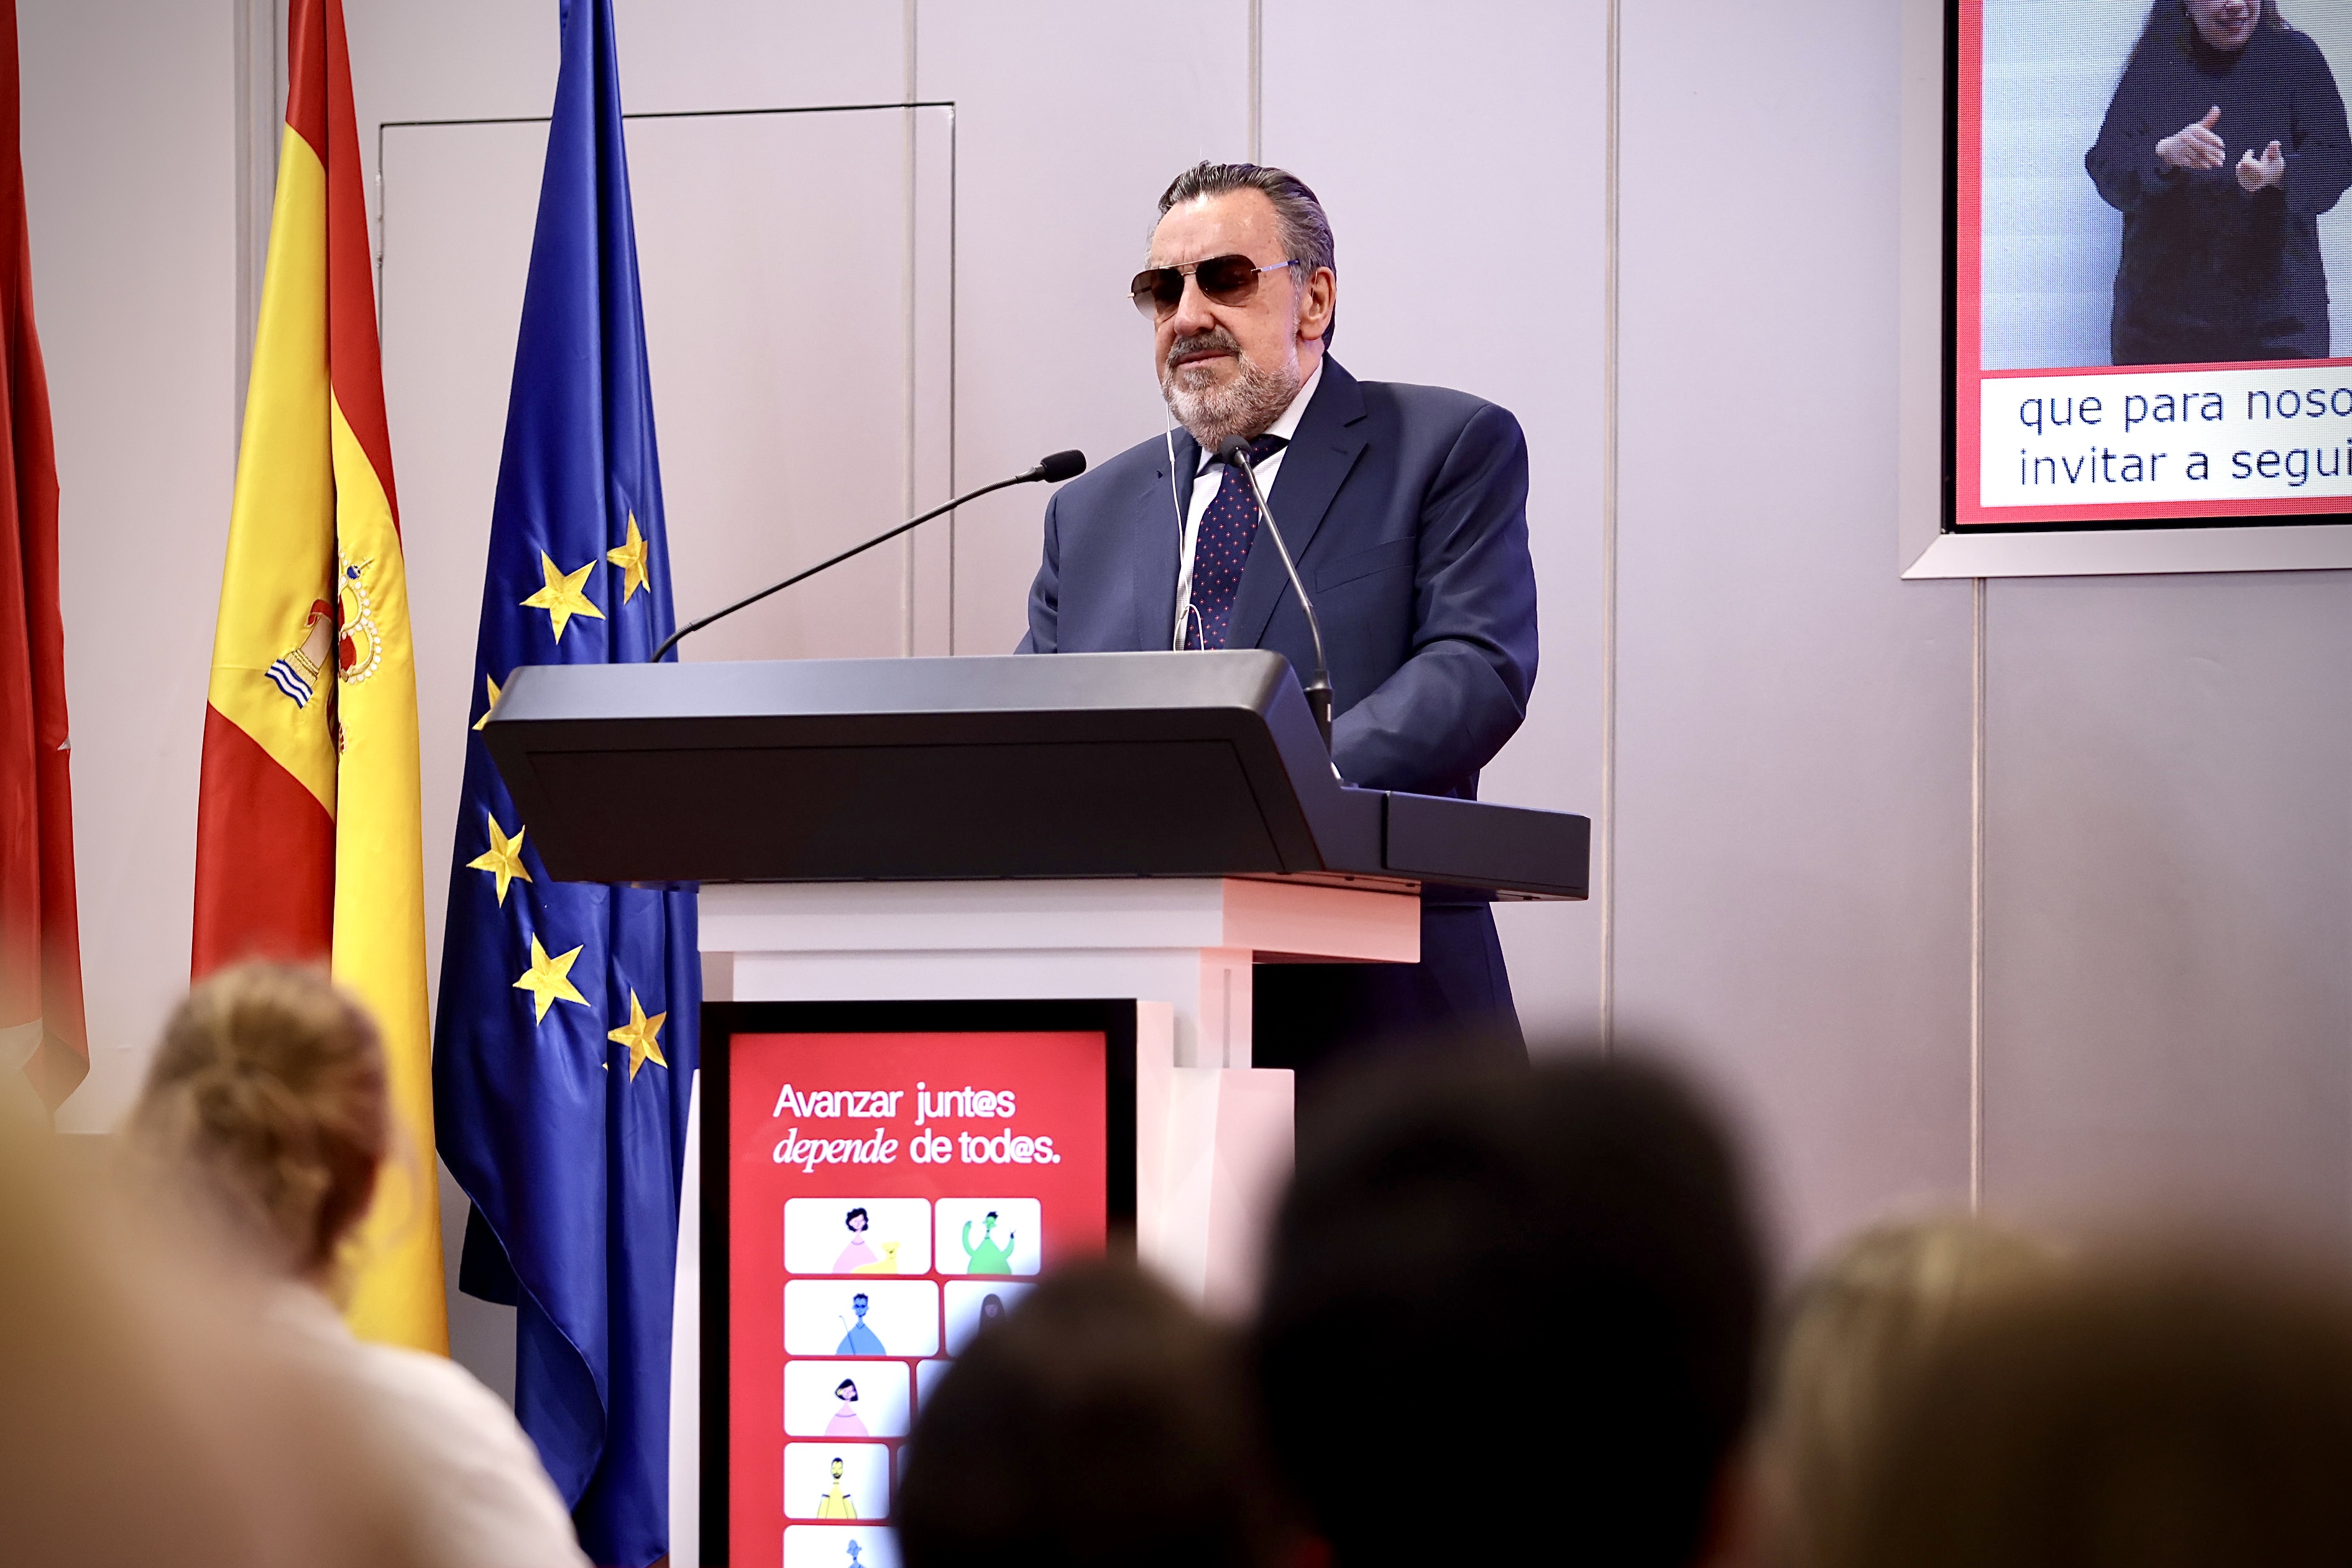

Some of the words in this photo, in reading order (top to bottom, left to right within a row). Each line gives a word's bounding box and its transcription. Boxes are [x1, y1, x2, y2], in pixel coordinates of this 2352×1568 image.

[2019, 397, 2102, 436] que
[2125, 392, 2222, 433] para
[2247, 387, 2352, 420] noso
[2020, 446, 2167, 485] invitar
[2185, 451, 2208, 480] a
[2231, 437, 2352, 487] segui
[773, 1083, 904, 1118] Avanzar
[914, 1081, 1016, 1126] junt@s
[773, 1127, 899, 1173] depende
[910, 1127, 953, 1163] de
[958, 1127, 1061, 1163] tod@s.
